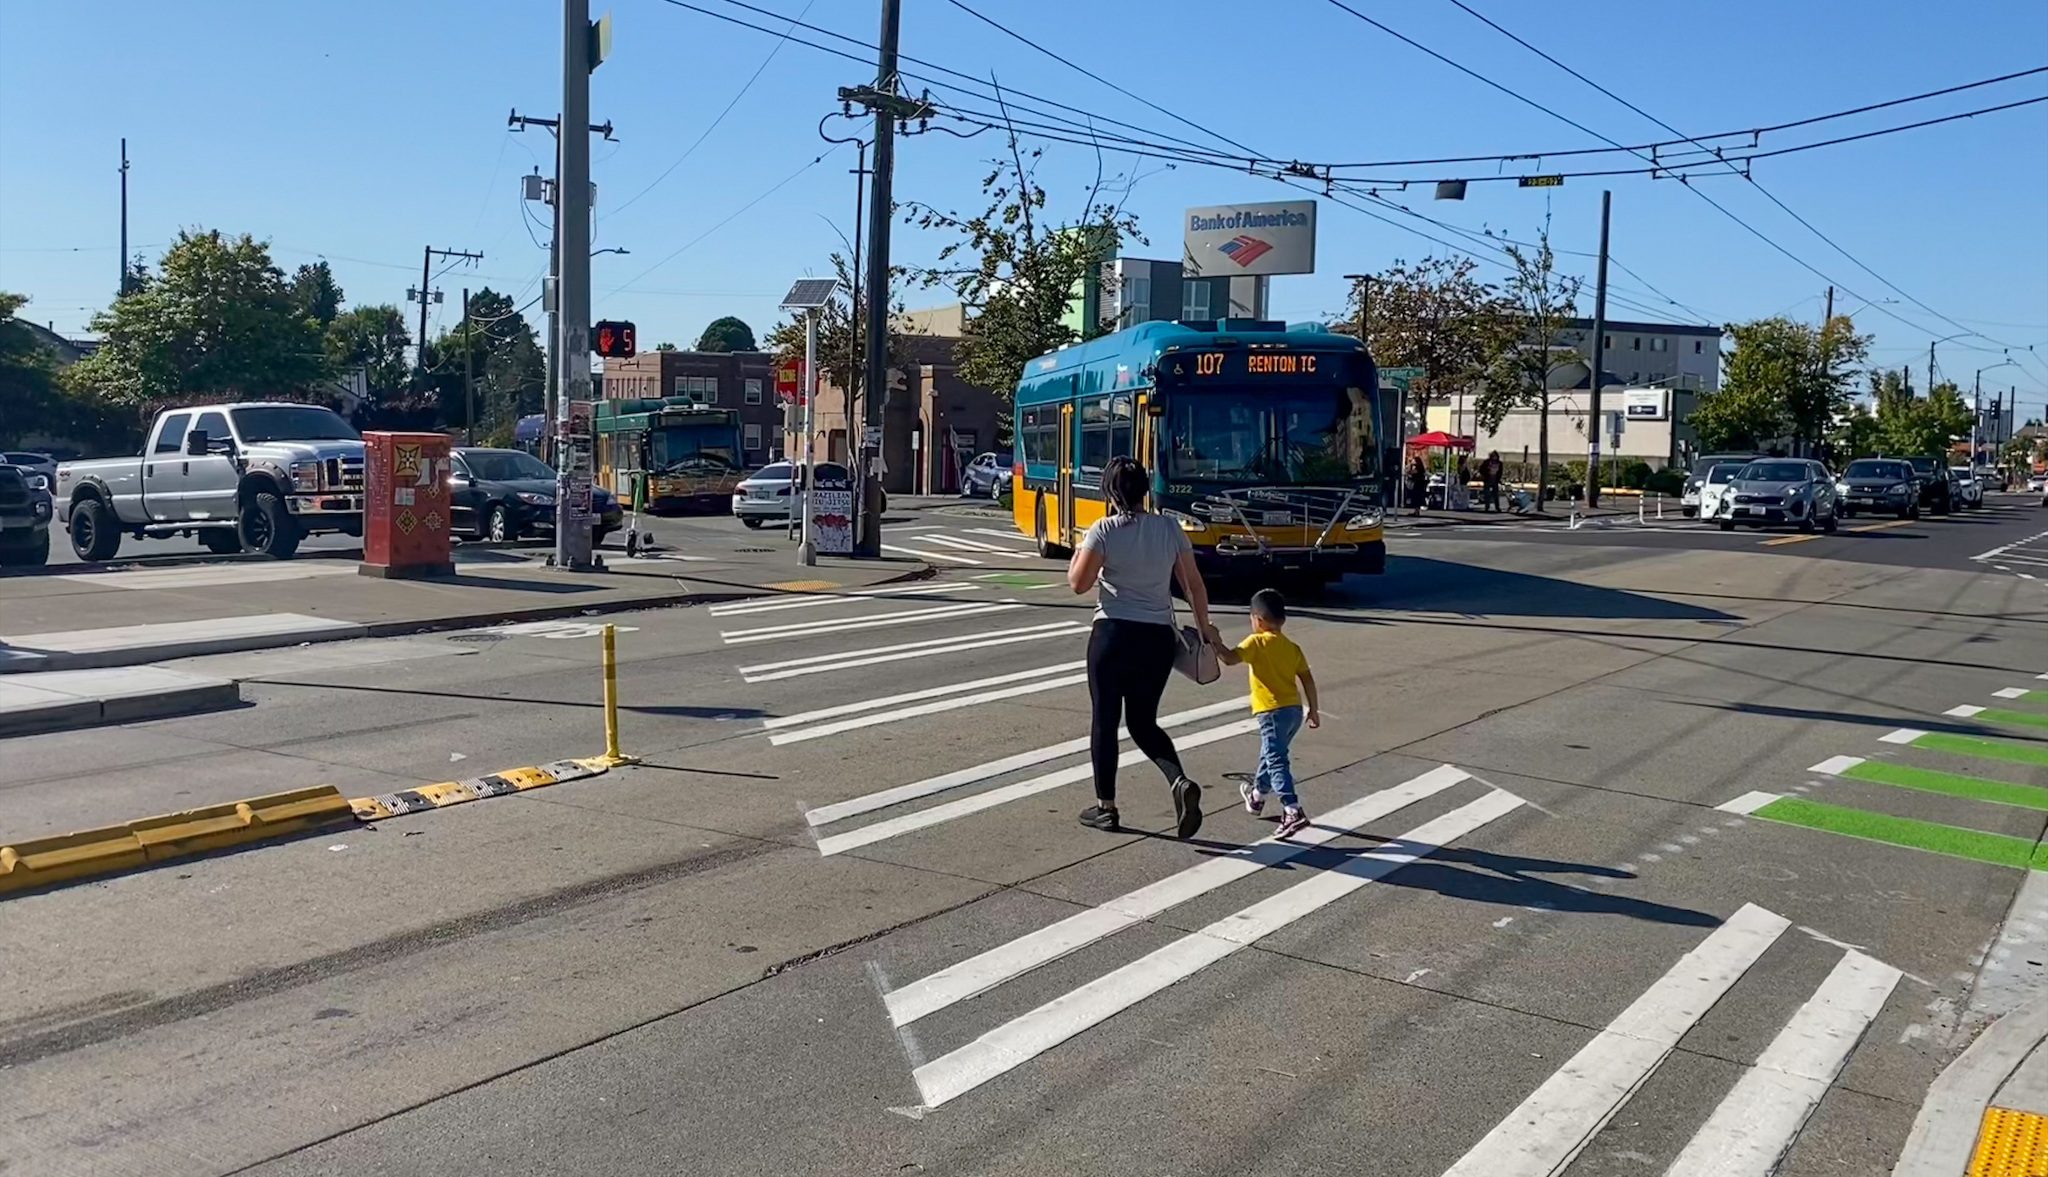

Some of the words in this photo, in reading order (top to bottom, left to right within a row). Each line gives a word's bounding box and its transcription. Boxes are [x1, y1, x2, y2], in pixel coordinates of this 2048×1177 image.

[1190, 213, 1225, 231] Bank
[1225, 212, 1242, 228] of
[1242, 209, 1307, 228] America
[623, 329, 633, 351] 5
[1196, 353, 1224, 375] 107
[1248, 355, 1296, 373] RENTON
[1300, 355, 1317, 372] TC
[1168, 485, 1193, 494] 3722
[1359, 485, 1379, 494] 3722
